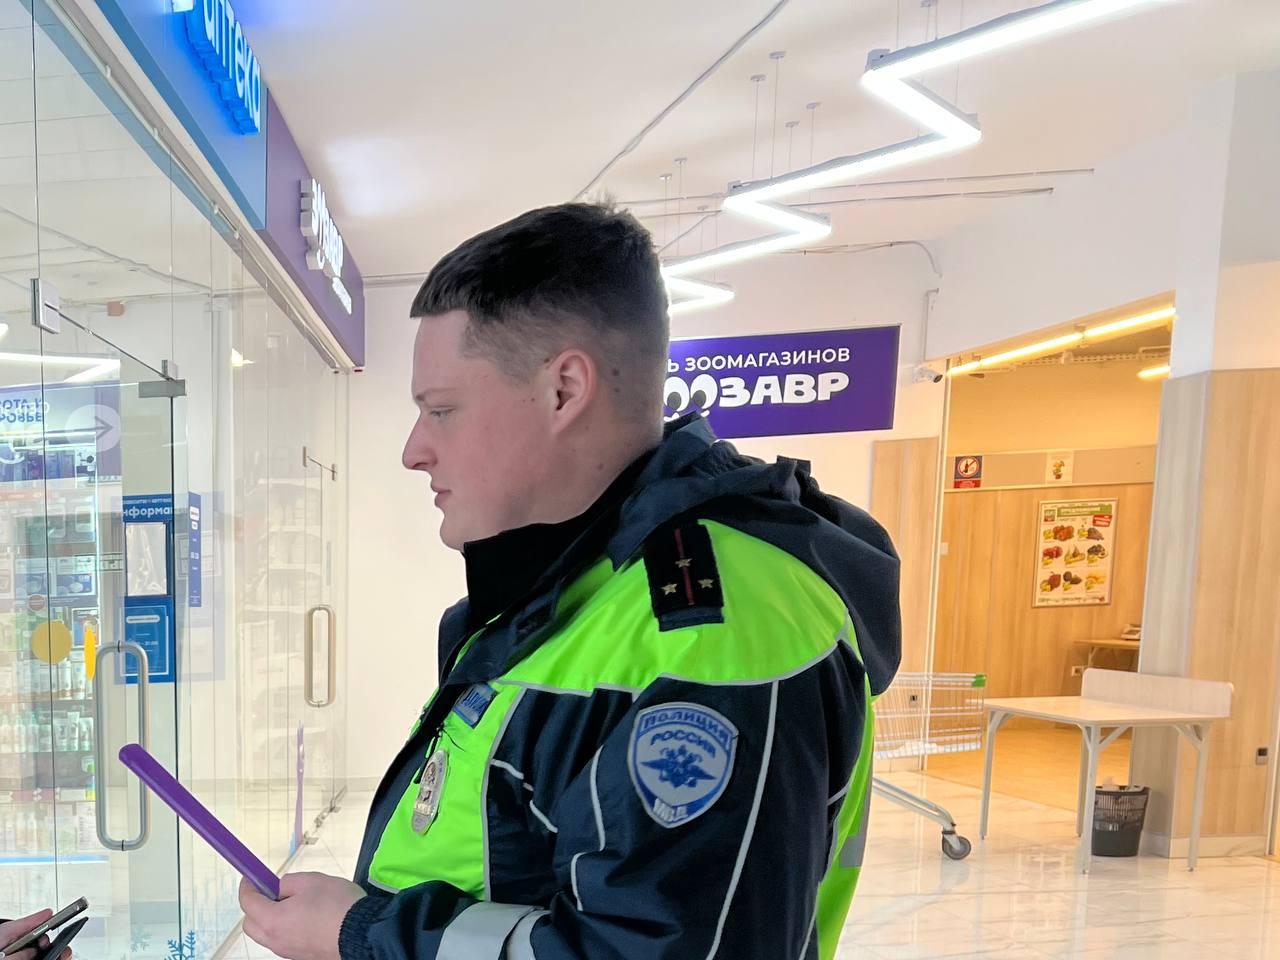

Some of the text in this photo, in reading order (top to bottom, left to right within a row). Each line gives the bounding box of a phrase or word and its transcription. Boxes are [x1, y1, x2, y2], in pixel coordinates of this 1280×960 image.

[685, 348, 850, 372] ЗООМАГАЗИНОВ
[663, 371, 850, 421] ООЗАВР
[644, 711, 731, 751] ПОЛИЦИЯ
[650, 730, 716, 759] РОССИЯ
[653, 797, 688, 822] МВД
